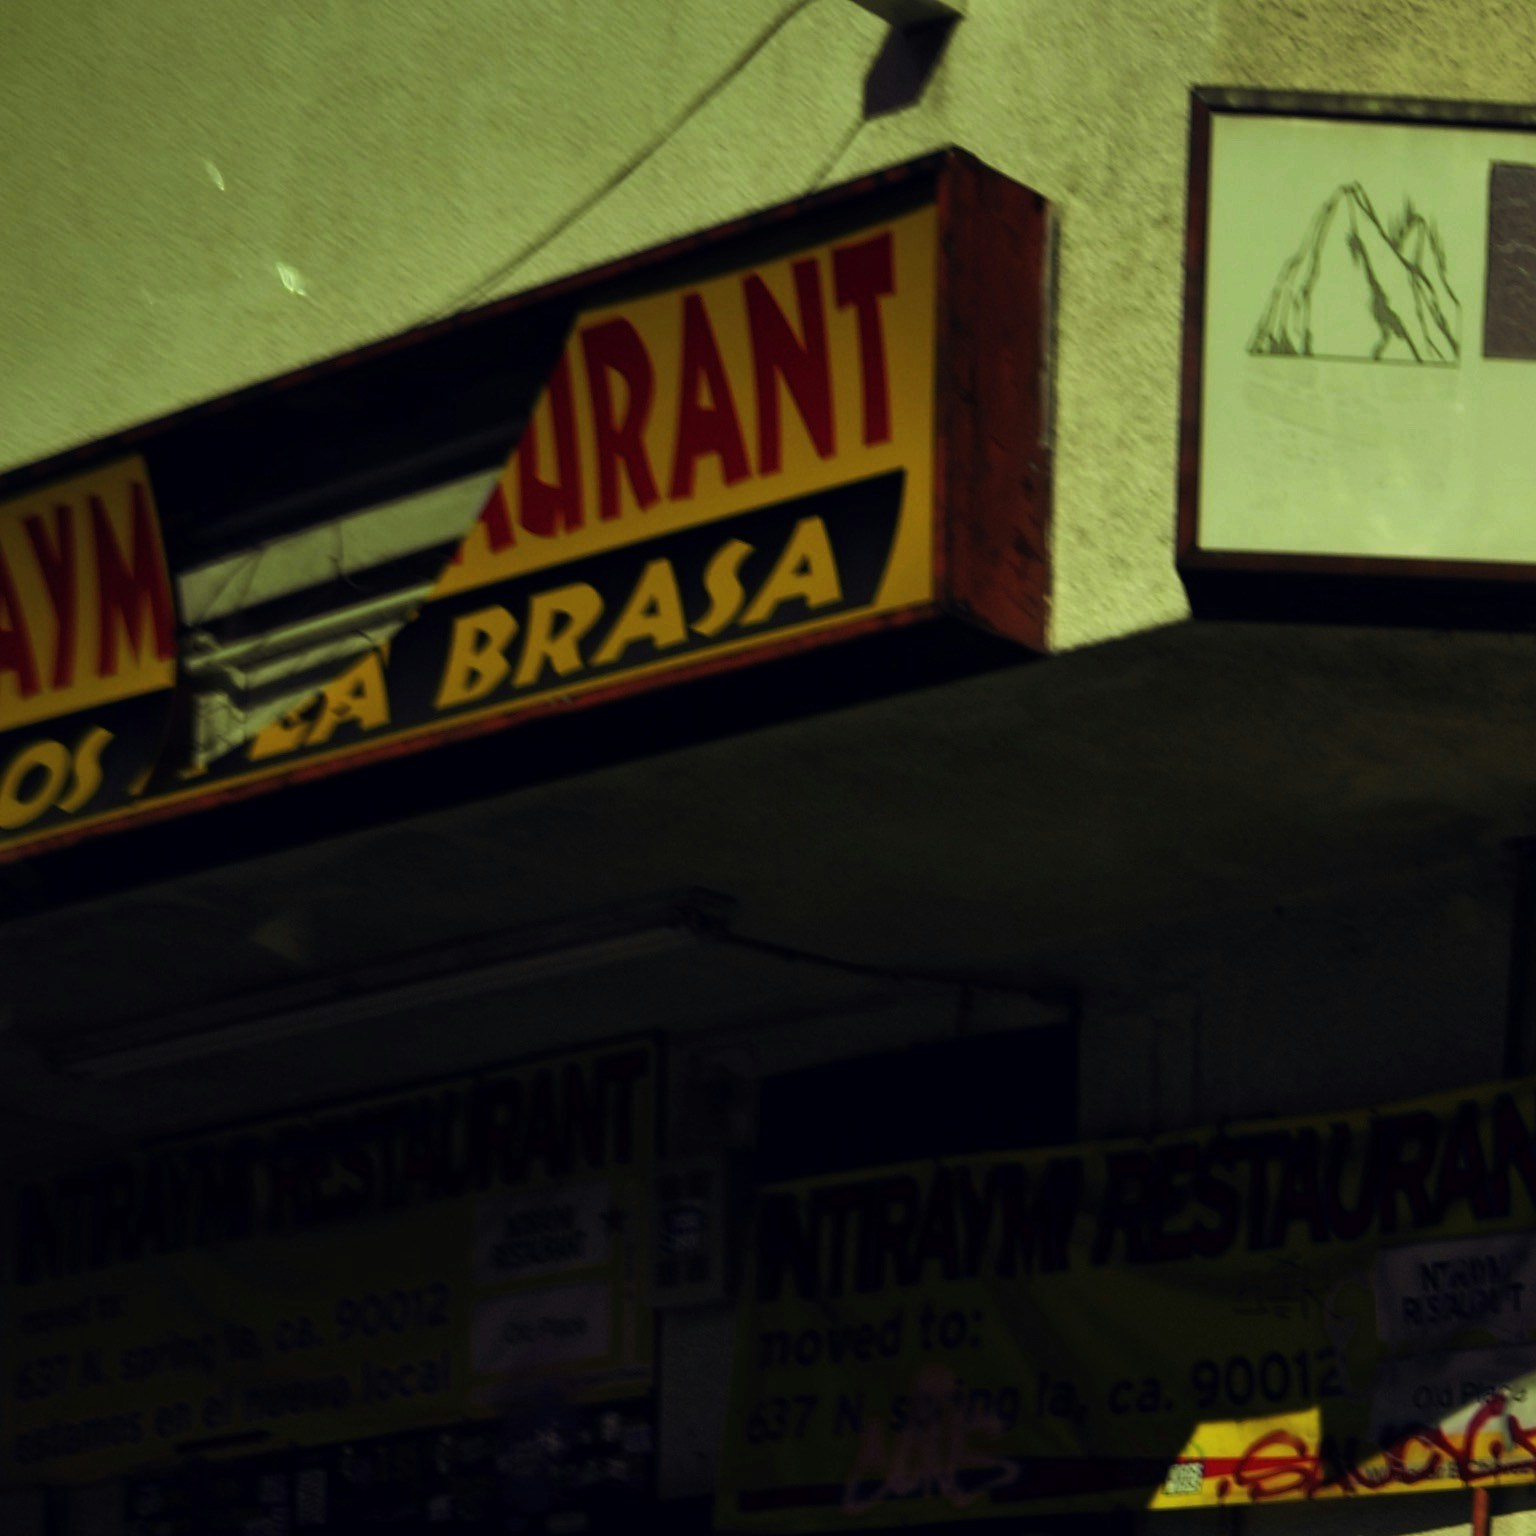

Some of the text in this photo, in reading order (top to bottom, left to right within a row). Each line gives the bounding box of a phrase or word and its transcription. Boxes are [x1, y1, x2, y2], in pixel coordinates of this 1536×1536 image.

[433, 513, 844, 709] BRASA
[333, 1281, 451, 1343] 90012
[919, 1298, 984, 1352] to:
[1105, 1377, 1177, 1417] ca.
[1191, 1344, 1346, 1408] 90012
